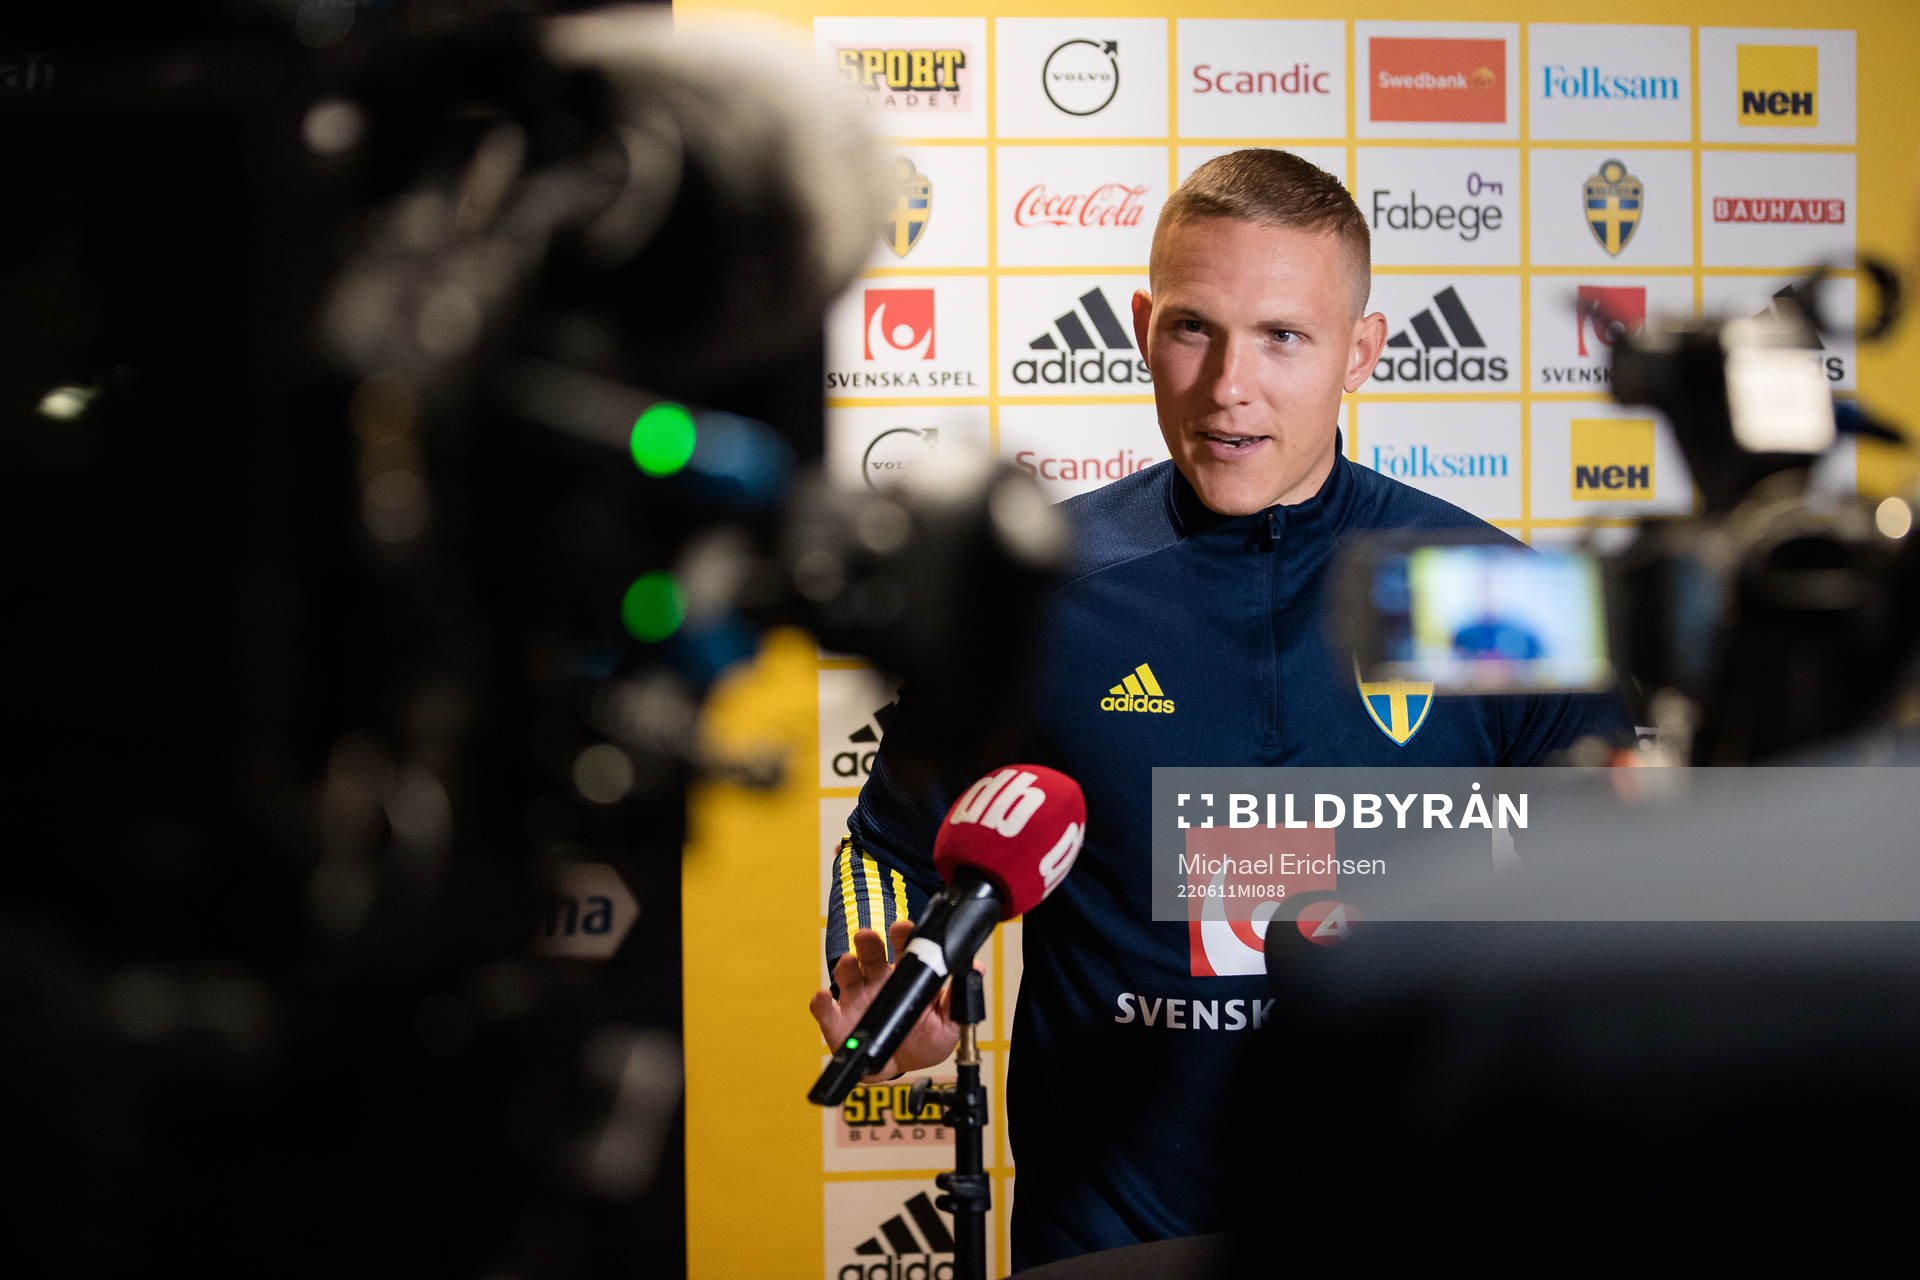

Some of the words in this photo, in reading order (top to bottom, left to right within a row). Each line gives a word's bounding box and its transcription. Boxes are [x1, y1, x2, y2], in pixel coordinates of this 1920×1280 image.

[837, 48, 966, 92] SPORT
[1052, 72, 1111, 82] VOLVO
[1193, 64, 1331, 95] Scandic
[1379, 69, 1468, 90] Swedbank
[1542, 65, 1680, 99] Folksam
[864, 93, 961, 107] LADET
[1373, 190, 1503, 241] Fabege
[1714, 199, 1845, 223] BAUHAUS
[827, 371, 921, 389] SVENSKA
[928, 371, 978, 388] SPEL
[1371, 349, 1509, 382] adidas
[1372, 444, 1508, 478] Folksam
[1100, 693, 1176, 714] adidas
[950, 768, 1047, 839] db
